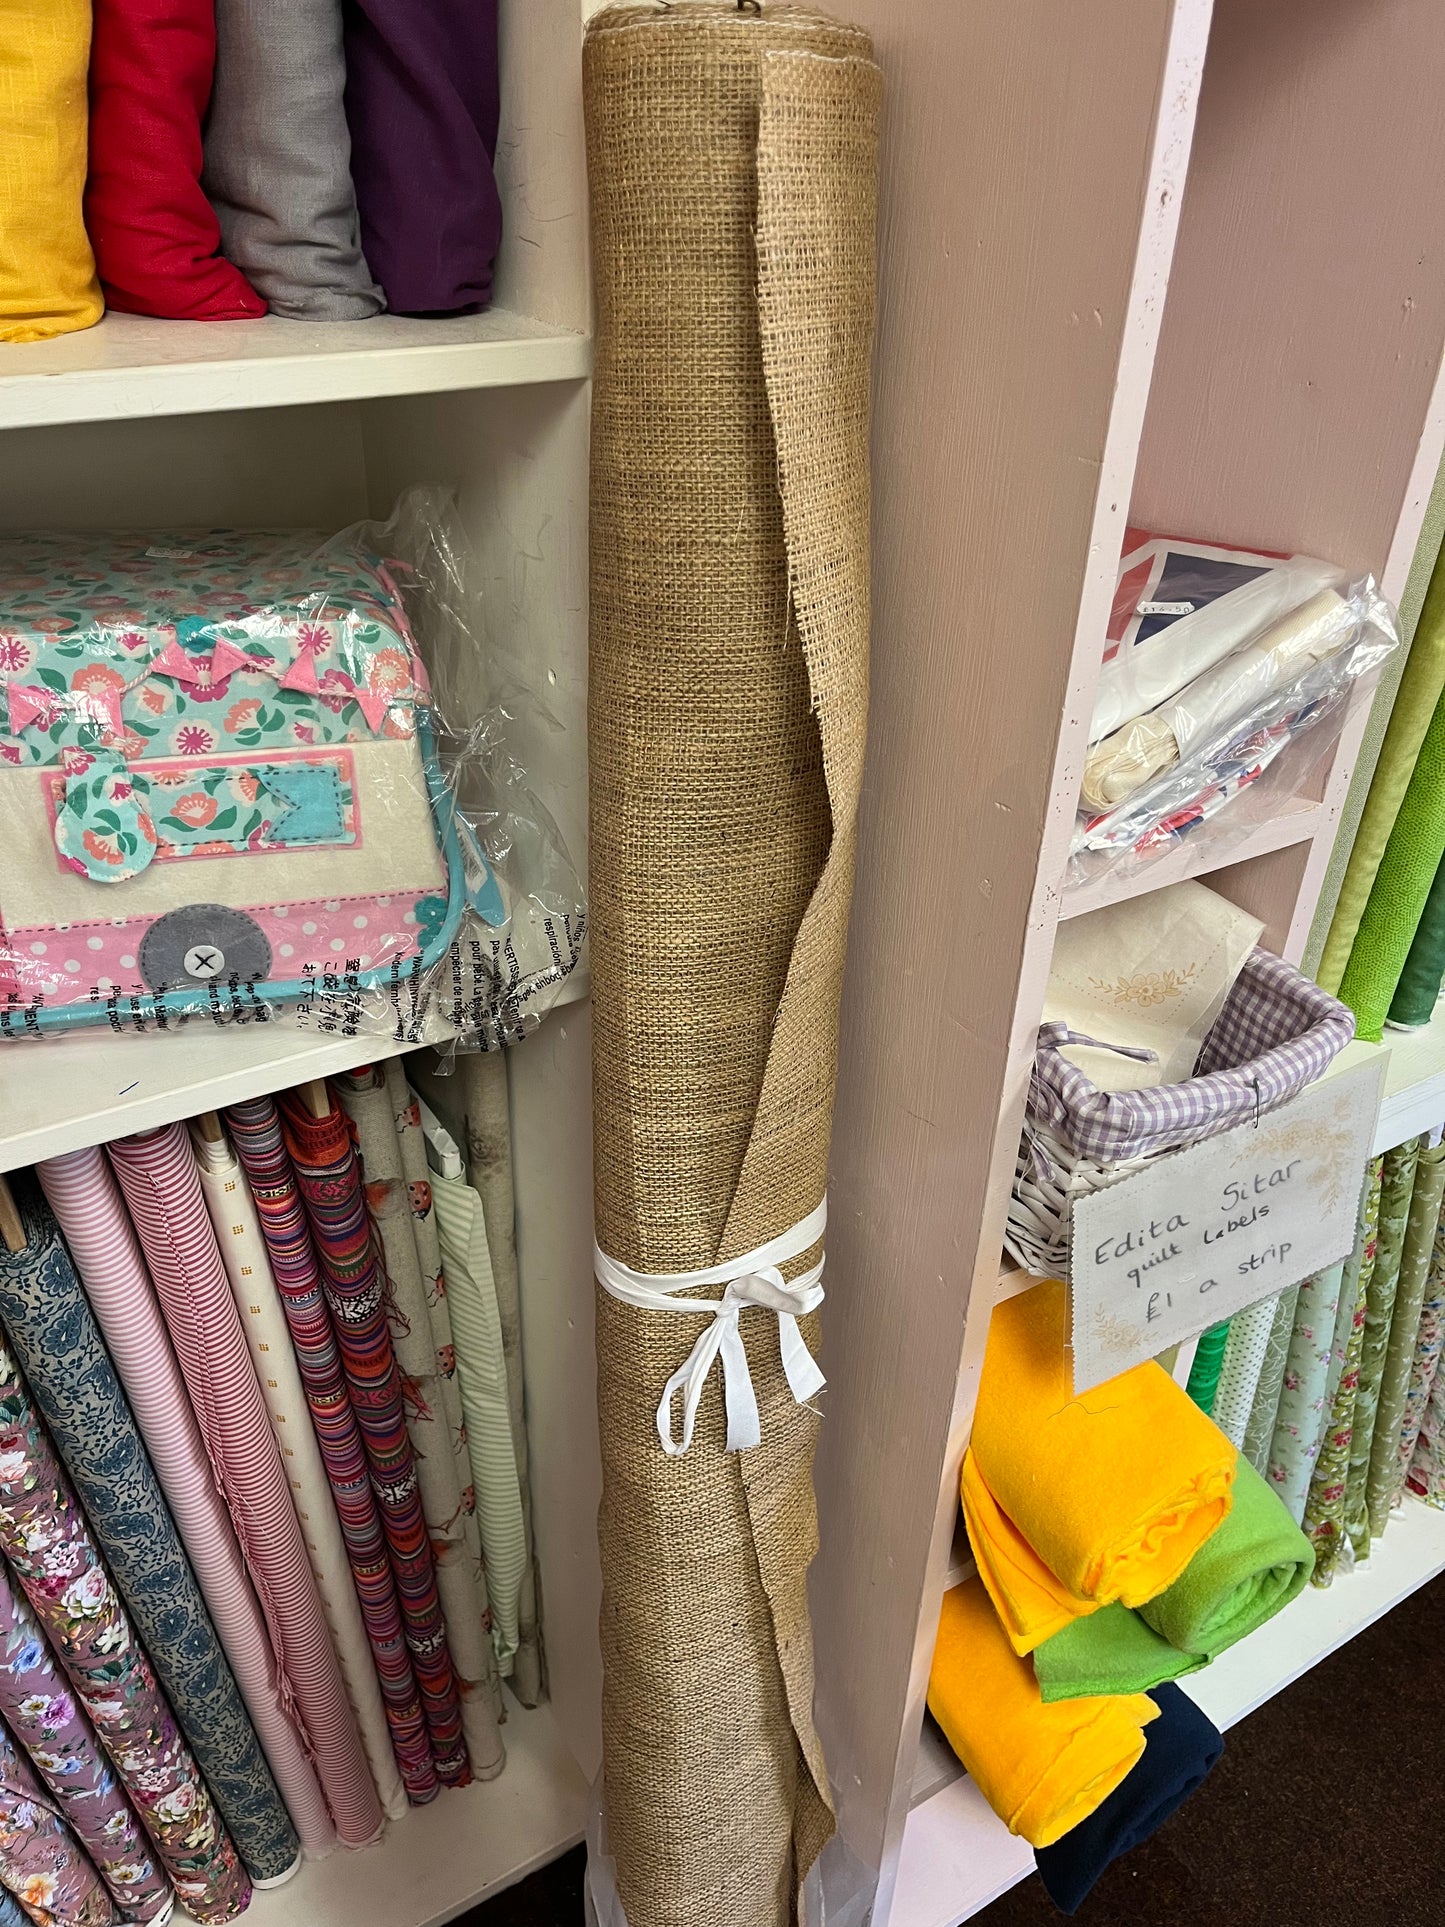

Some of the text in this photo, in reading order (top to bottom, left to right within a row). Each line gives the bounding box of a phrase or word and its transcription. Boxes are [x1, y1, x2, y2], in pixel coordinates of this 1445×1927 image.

[469, 941, 482, 961] pour
[453, 986, 464, 996] de
[1094, 1158, 1301, 1265] Edita Sitar
[1127, 1243, 1183, 1289] quilt
[1146, 1240, 1293, 1324] £1 a strip
